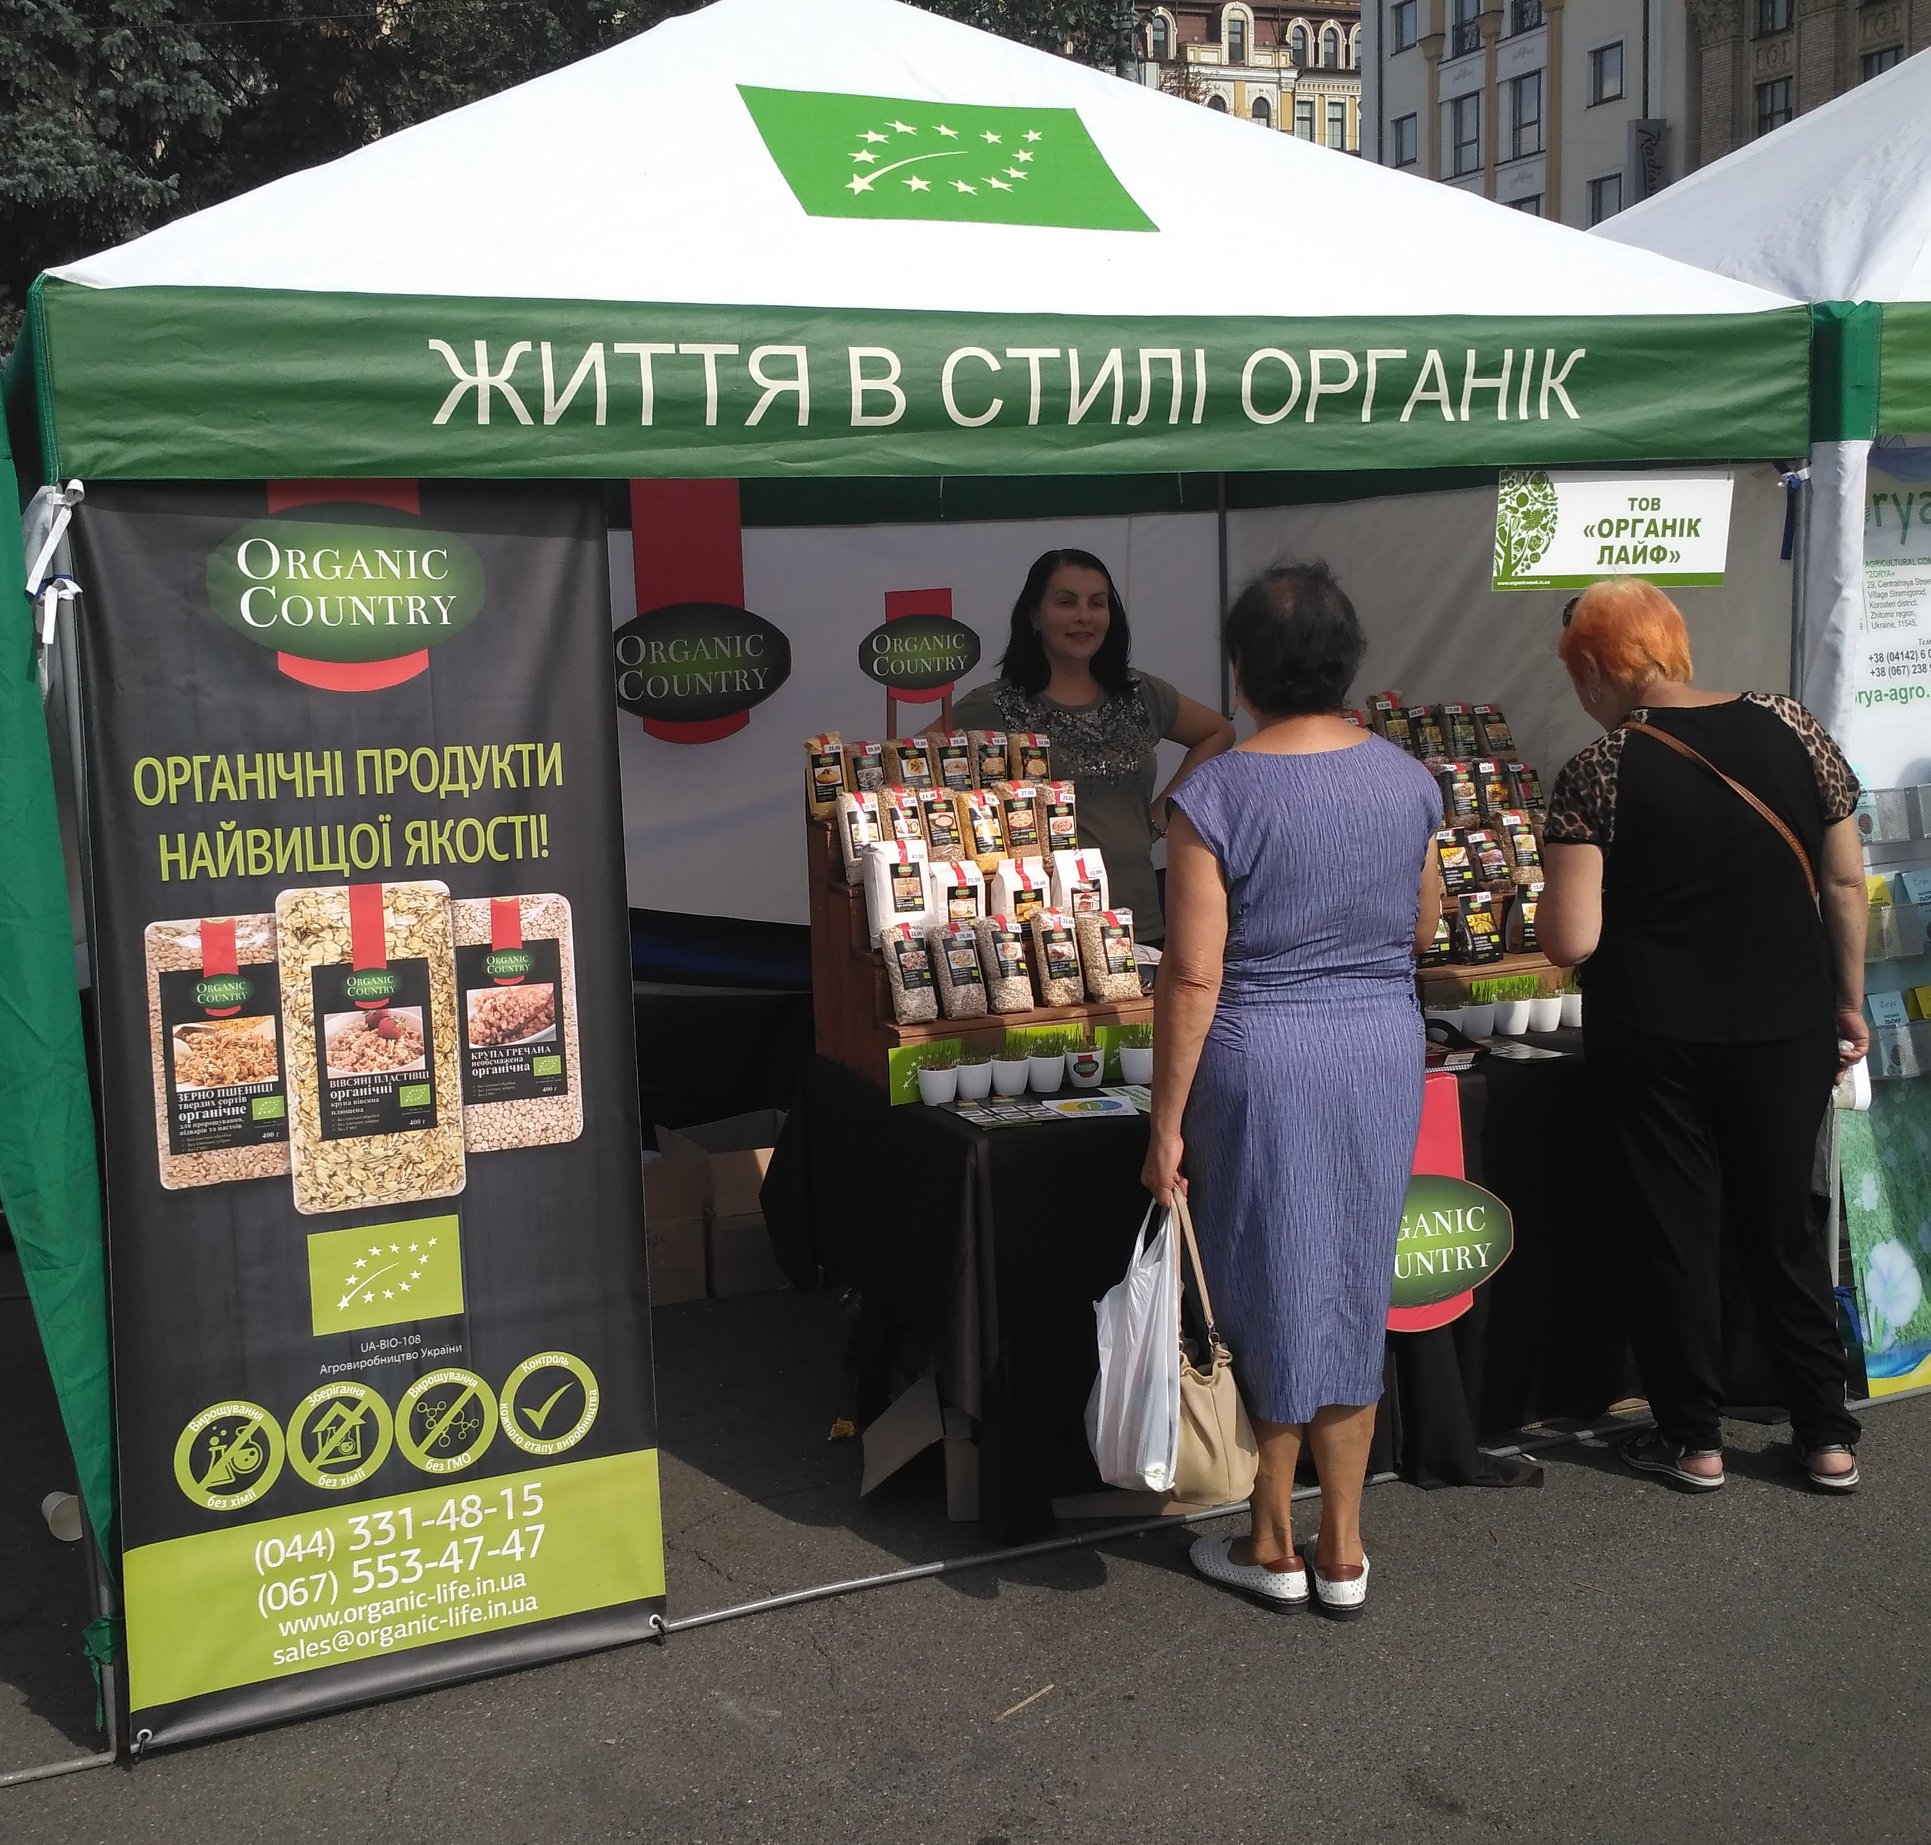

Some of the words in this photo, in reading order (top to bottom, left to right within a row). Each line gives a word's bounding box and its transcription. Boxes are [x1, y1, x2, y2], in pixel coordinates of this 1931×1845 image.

[429, 339, 810, 427] ЖИТТЯ
[847, 346, 907, 428] В
[942, 346, 1206, 427] СТИЛІ
[1241, 347, 1586, 425] ОРГАНІК
[1627, 497, 1662, 512] ТОВ
[1583, 518, 1702, 539] «ОРГАНІК
[236, 538, 449, 581] ORGANIC
[1597, 540, 1681, 566] ЛАЙФ»
[1865, 558, 1917, 568] AGRICULTURAL
[1867, 591, 1888, 599] Village
[1869, 601, 1896, 609] Korosten
[239, 586, 457, 628] COUNTRY
[615, 633, 765, 667] ORGANIC
[871, 633, 966, 656] ORGANIC
[872, 655, 968, 678] COUNTRY
[1868, 652, 1884, 663] +38
[1886, 649, 1918, 664] (04142)
[1920, 649, 1926, 660] 6
[1869, 666, 1886, 678] +38
[1889, 665, 1910, 679] (067)
[1911, 663, 1927, 675] 238
[617, 667, 770, 701] COUNTRY
[133, 750, 344, 806] ОРГАНІЧНІ
[356, 742, 564, 799] ПРОДУКТИ
[159, 814, 392, 882] НАЙВИЩОЇ
[404, 813, 549, 866] ЯКОСТІ!
[486, 955, 529, 966] ORGANIC
[486, 964, 530, 975] COUNTRY
[196, 981, 246, 994] ORGANIC
[346, 975, 394, 987] ORGANIC
[347, 985, 396, 997] COUNTRY
[197, 991, 248, 1004] COUNTRY
[471, 1050, 504, 1060] КРУПА
[506, 1045, 551, 1057] ГРЕЧАНА
[471, 1056, 524, 1067] необсмажена
[329, 1077, 371, 1089] ВІВСЯНІ
[374, 1070, 430, 1085] ПЛАСТІВЦІ
[471, 1063, 531, 1079] органічна
[177, 1090, 215, 1102] ЗЕРНО
[217, 1083, 274, 1097] ПШЕНИЦІ
[330, 1083, 393, 1101] органічні
[178, 1100, 216, 1110] твердих
[219, 1095, 248, 1107] сортів
[178, 1105, 247, 1123] органічне
[262, 1131, 275, 1139] 400
[360, 1334, 422, 1353] UA-BIO-108
[319, 1350, 419, 1375] Агровиробництво
[420, 1343, 463, 1358] України
[520, 1354, 570, 1374] Контроль
[304, 1383, 366, 1407] Зберігання
[407, 1371, 479, 1399] Вирощування
[187, 1403, 264, 1434] Вирощування
[500, 1402, 524, 1446] кожного
[524, 1440, 554, 1454] етапу
[556, 1388, 598, 1451] виробництва
[425, 1458, 445, 1472] без
[447, 1451, 472, 1471] ГМО
[318, 1474, 337, 1488] без
[340, 1467, 366, 1487] хімії
[207, 1496, 227, 1509] без
[230, 1487, 257, 1508] хімії
[254, 1526, 336, 1577] (044)
[347, 1482, 545, 1551] 331-48-15
[257, 1569, 339, 1619] (067)
[351, 1523, 546, 1594] 553-47-47
[277, 1571, 527, 1638] www.organic-life.in.ua
[272, 1593, 539, 1665] sales@organic-life.in.ua
